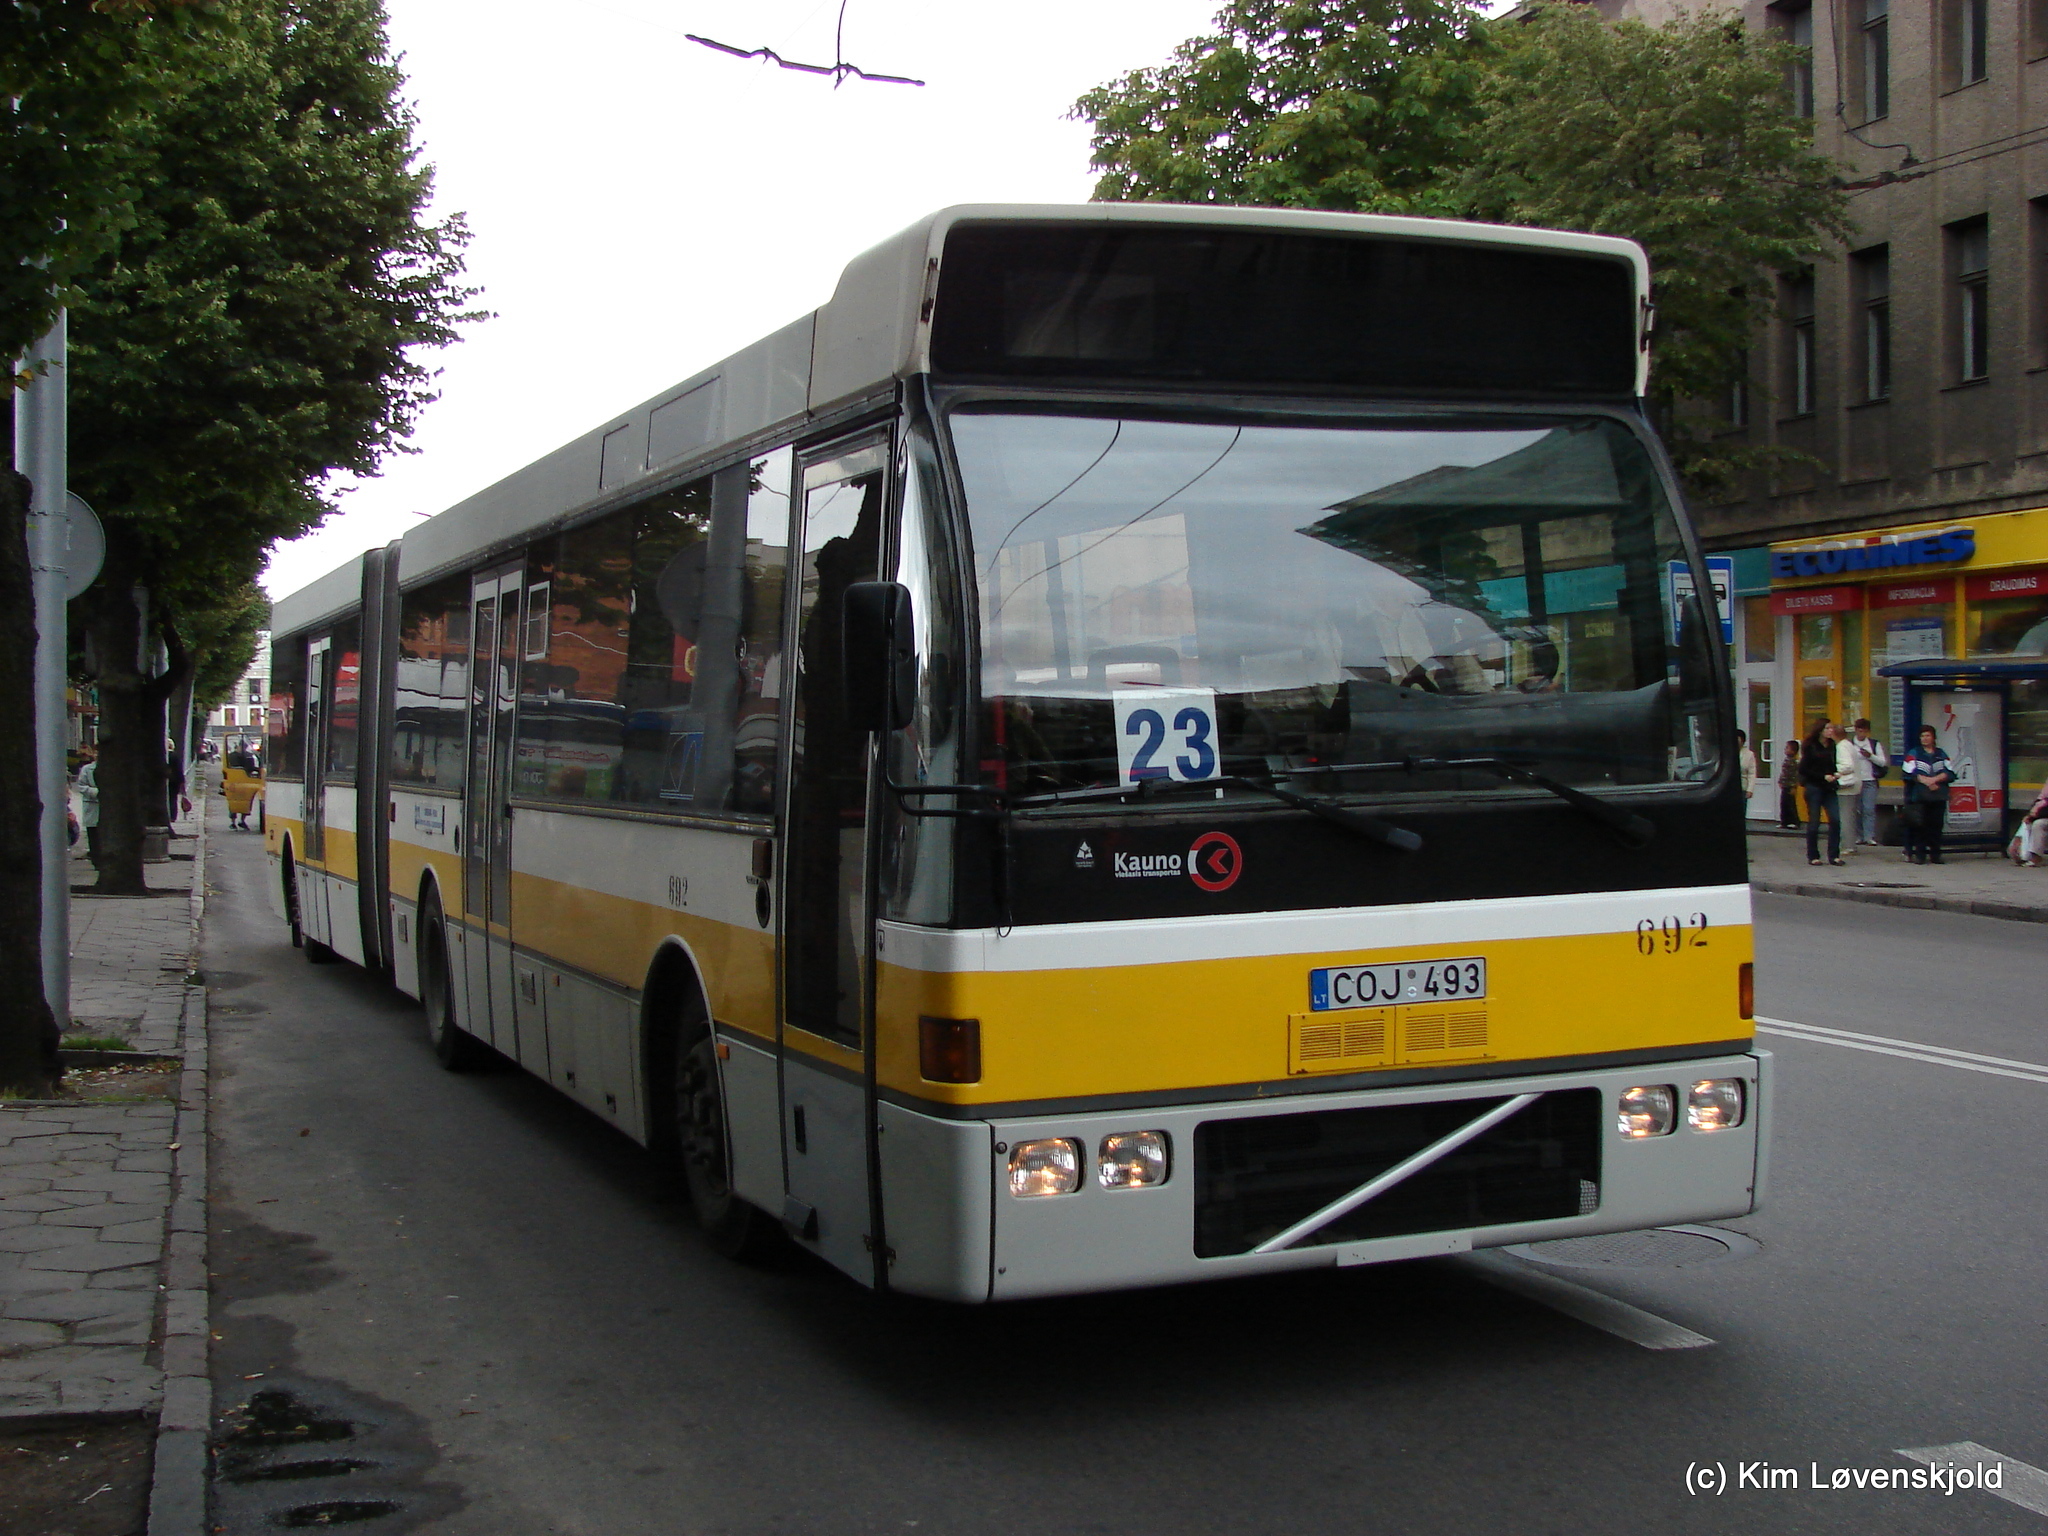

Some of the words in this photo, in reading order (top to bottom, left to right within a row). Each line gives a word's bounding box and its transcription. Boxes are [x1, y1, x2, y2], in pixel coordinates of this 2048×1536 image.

[1771, 526, 1976, 578] ECOLINES
[1989, 577, 2037, 592] DRAUDIMAS
[1126, 707, 1215, 782] 23
[1114, 852, 1182, 872] Kauno
[1142, 869, 1181, 878] transportas
[668, 875, 688, 907] 692
[1636, 911, 1708, 955] 692
[1313, 993, 1327, 1004] LT
[1333, 968, 1400, 1004] COJ
[1424, 963, 1480, 997] 493
